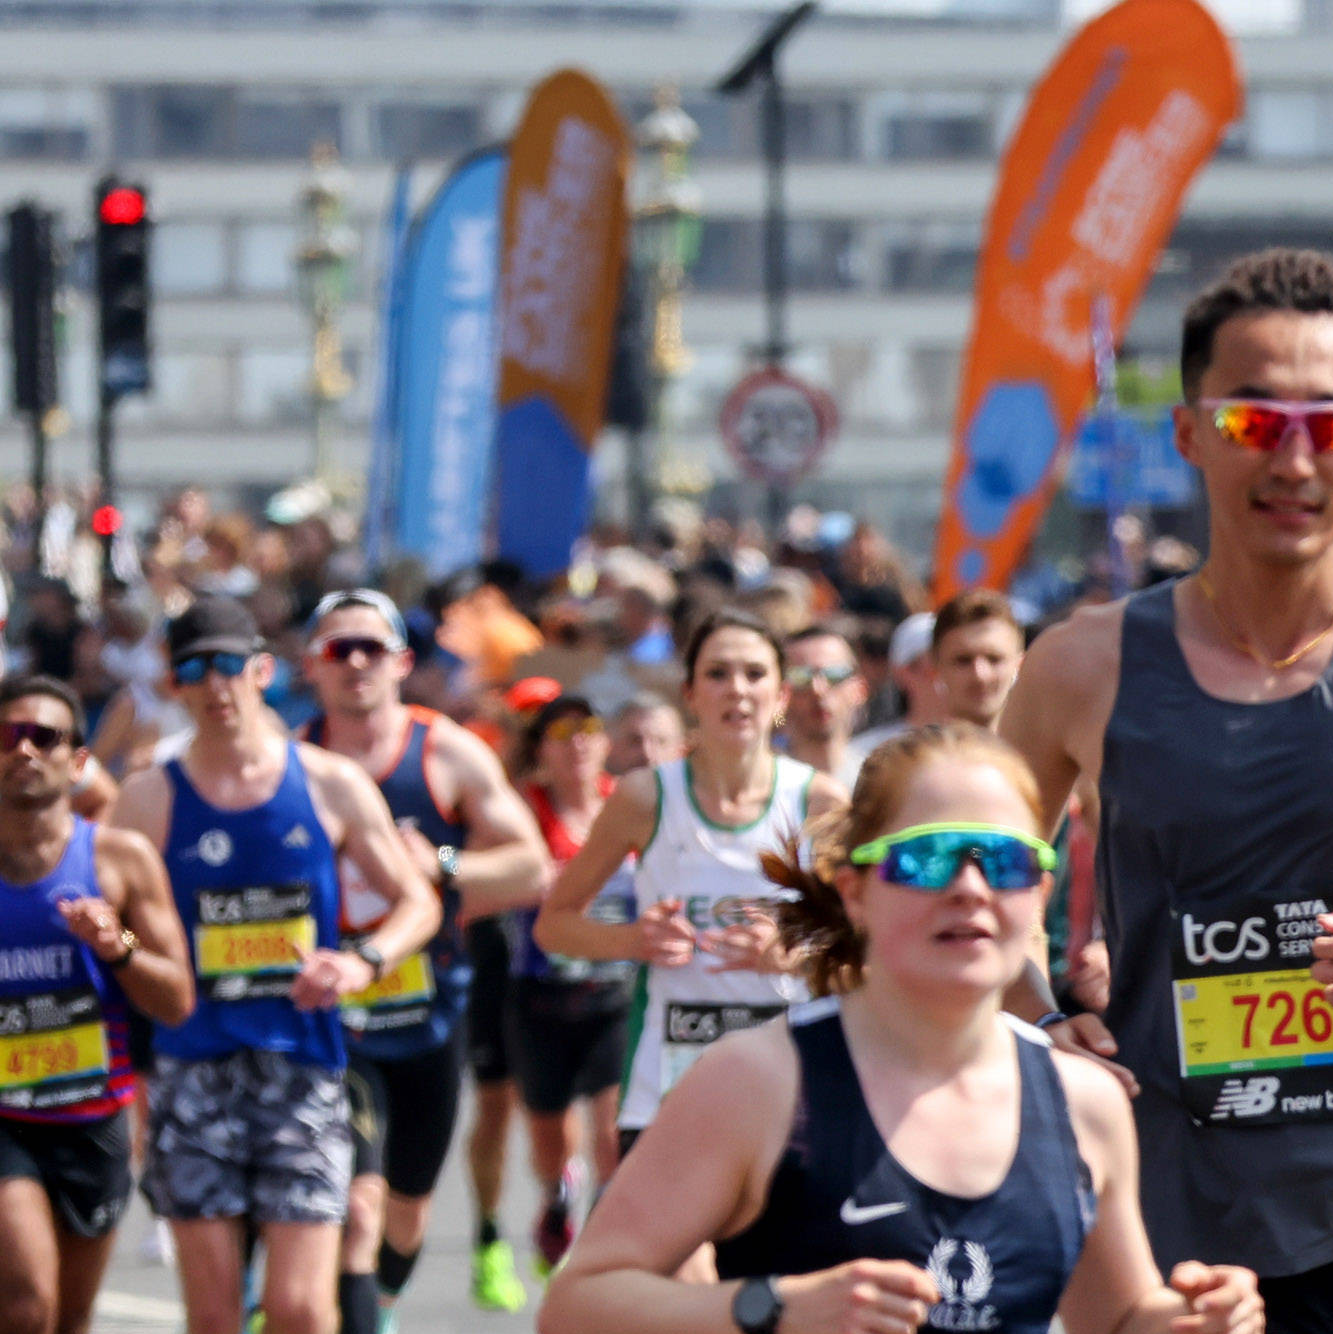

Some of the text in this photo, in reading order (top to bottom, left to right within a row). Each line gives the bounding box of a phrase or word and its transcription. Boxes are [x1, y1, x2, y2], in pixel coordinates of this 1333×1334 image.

[1273, 899, 1329, 920] TATA
[1183, 913, 1270, 967] tcs
[1281, 1095, 1323, 1113] new
